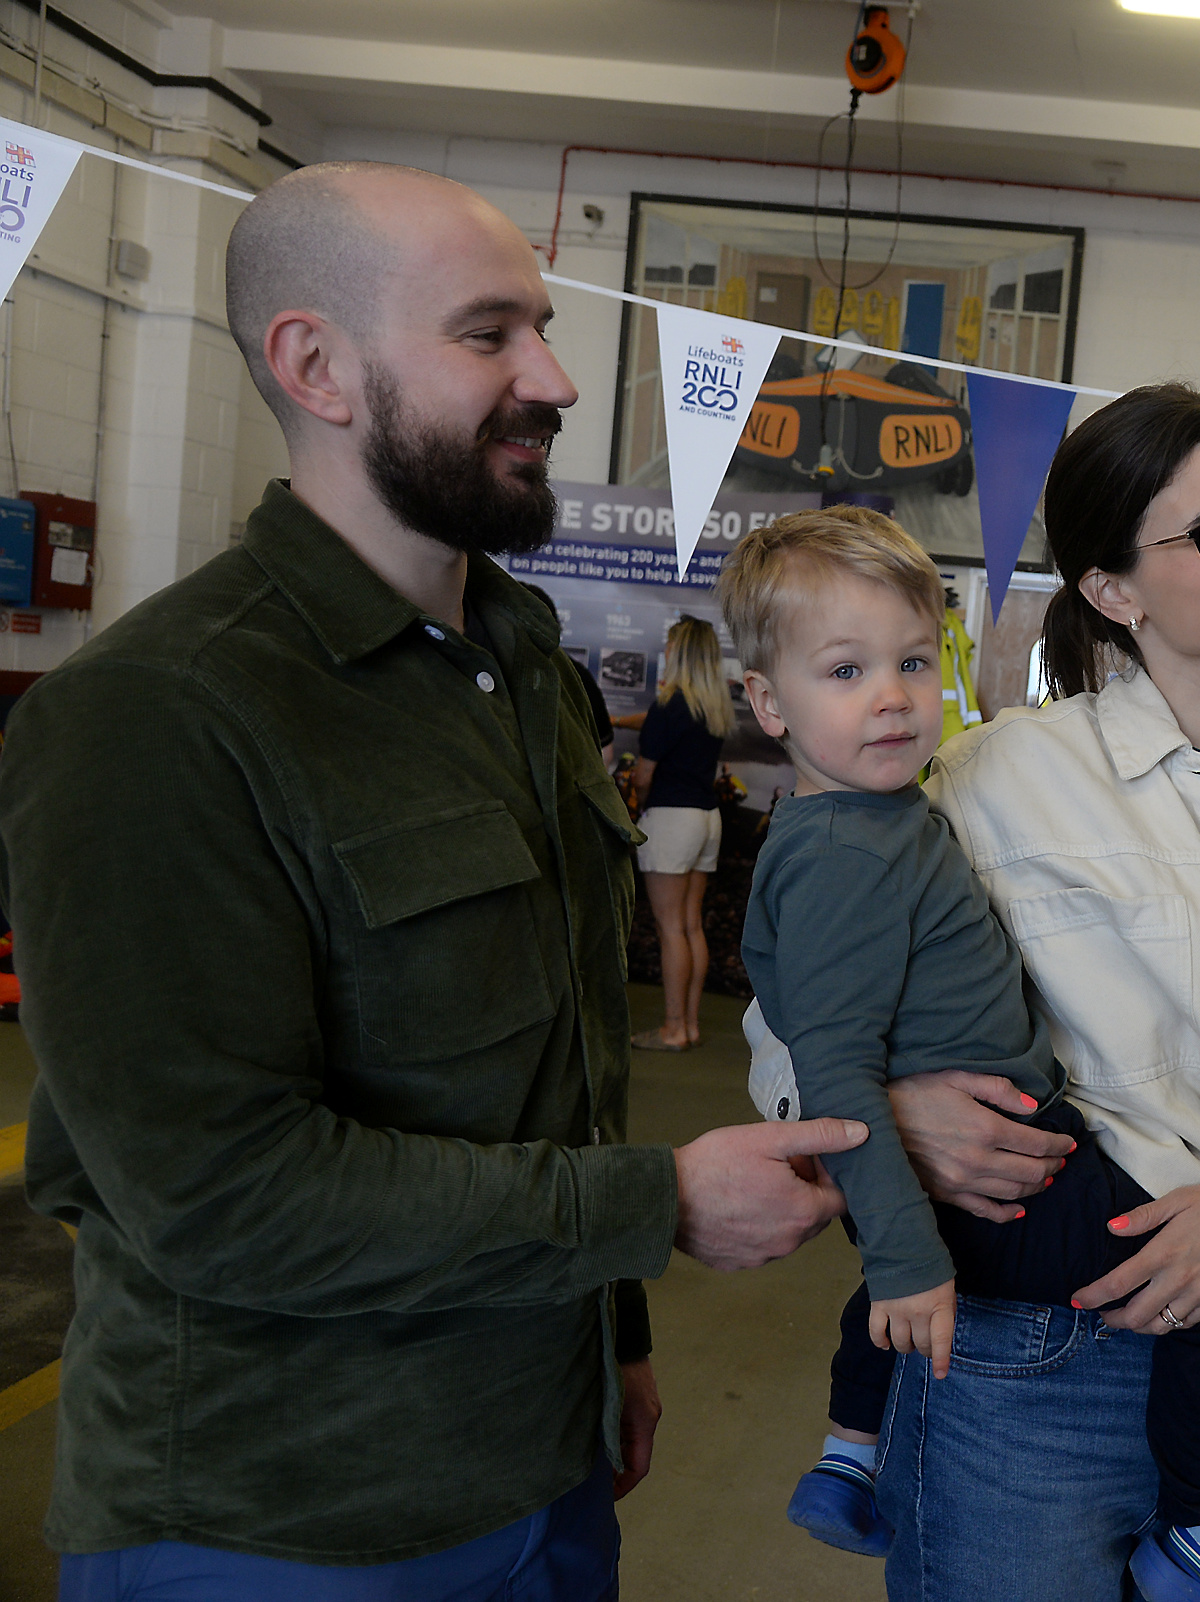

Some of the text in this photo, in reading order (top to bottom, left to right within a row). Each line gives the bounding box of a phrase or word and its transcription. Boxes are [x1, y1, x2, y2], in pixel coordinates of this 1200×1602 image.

[688, 346, 744, 366] Lifeboats
[684, 360, 742, 390] RNLI
[682, 382, 738, 411] 200
[680, 406, 736, 421] AND COUNTING
[743, 413, 787, 449] NLI
[894, 424, 953, 460] RNLI
[591, 504, 675, 537] STOR
[702, 510, 742, 540] SO
[555, 544, 628, 564] celebrating
[632, 549, 653, 563] 200
[700, 556, 721, 568] and
[512, 558, 530, 570] on
[532, 559, 577, 574] people
[579, 561, 603, 576] like
[606, 566, 628, 580] you
[631, 567, 644, 579] to
[646, 568, 672, 584] help
